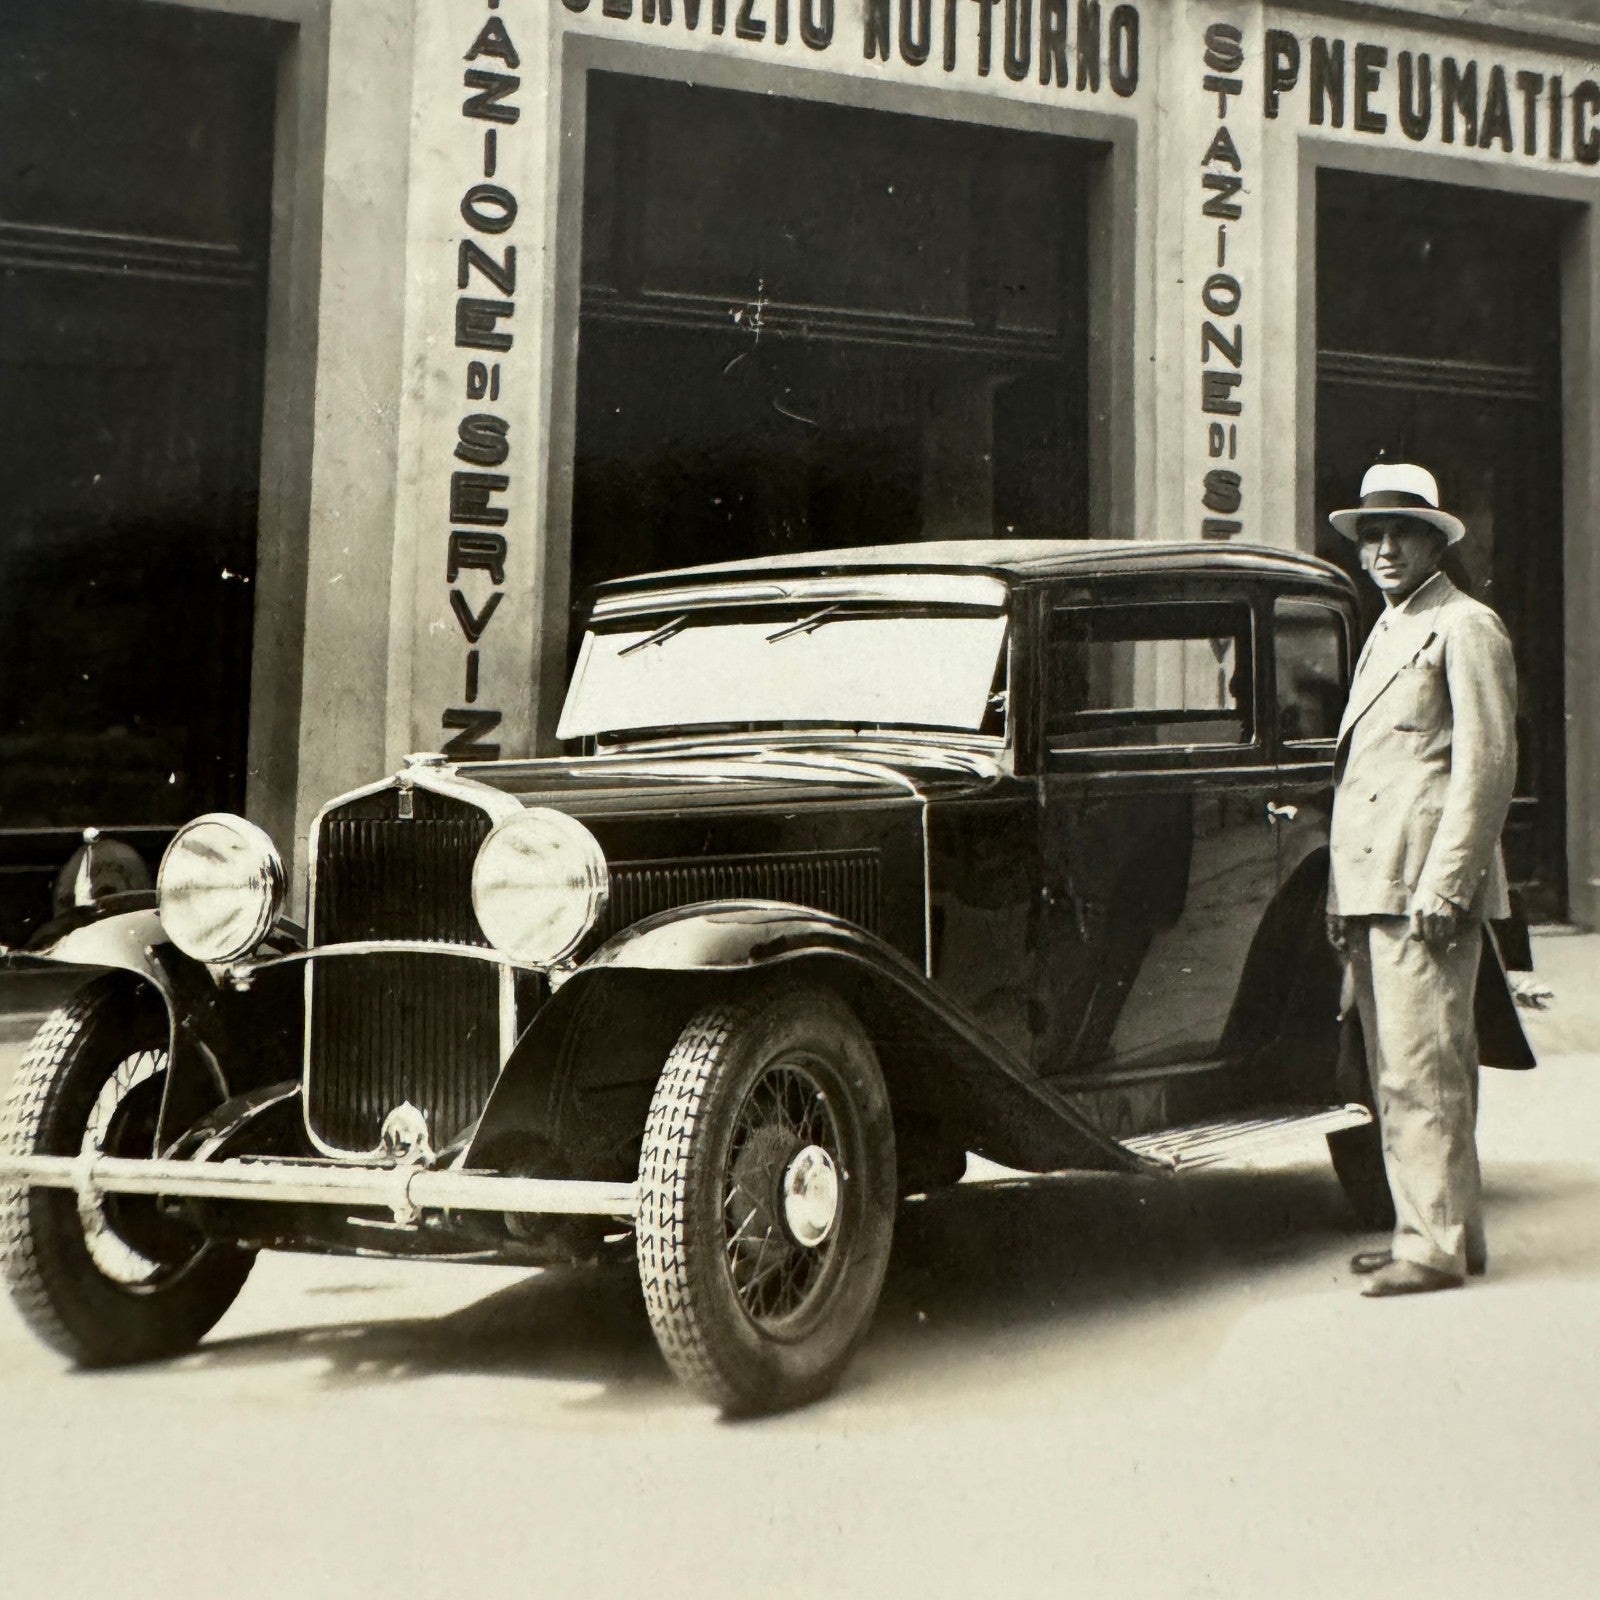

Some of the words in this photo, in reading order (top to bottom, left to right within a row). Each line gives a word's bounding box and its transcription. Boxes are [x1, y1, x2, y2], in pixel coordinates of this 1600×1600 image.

[1264, 28, 1600, 165] PNEUMATIC
[454, 0, 521, 353] AZIONE
[1201, 23, 1244, 416] STAZIONE
[466, 360, 500, 401] DI
[1208, 422, 1237, 460] DI
